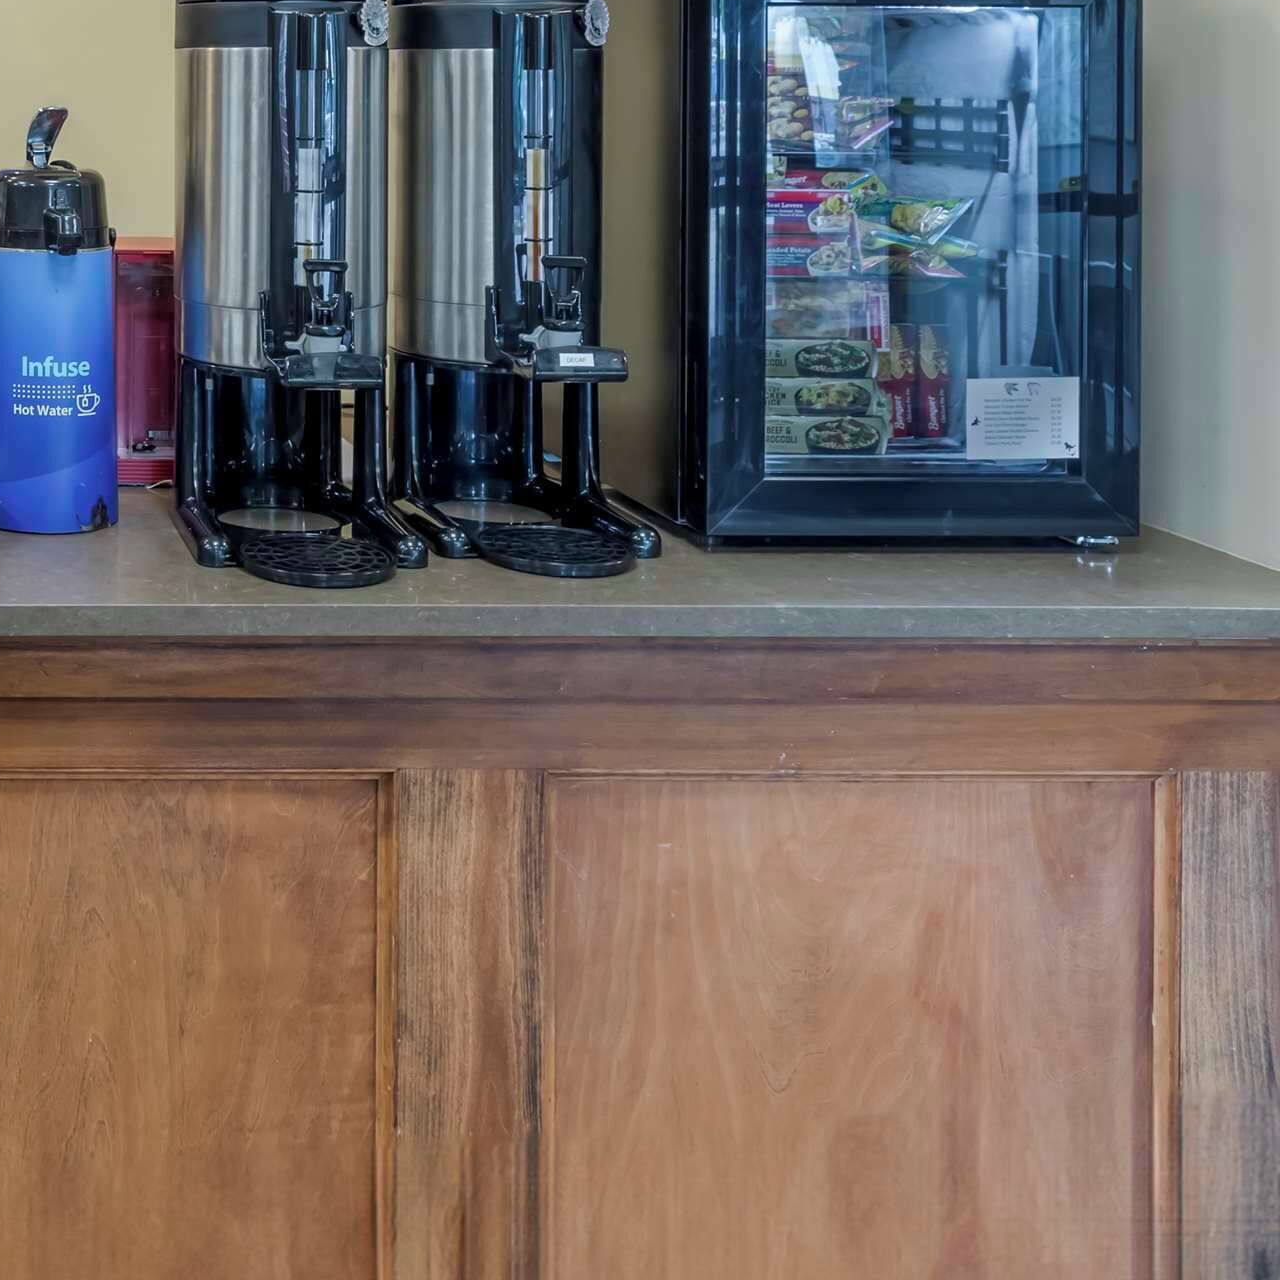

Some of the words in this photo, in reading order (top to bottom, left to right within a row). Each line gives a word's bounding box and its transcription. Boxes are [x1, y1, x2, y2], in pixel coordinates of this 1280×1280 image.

[22, 356, 90, 377] Infuse
[13, 403, 34, 415] Hot
[37, 404, 73, 416] Water
[766, 426, 783, 434] BEEF
[766, 435, 798, 443] ROCCOLI
